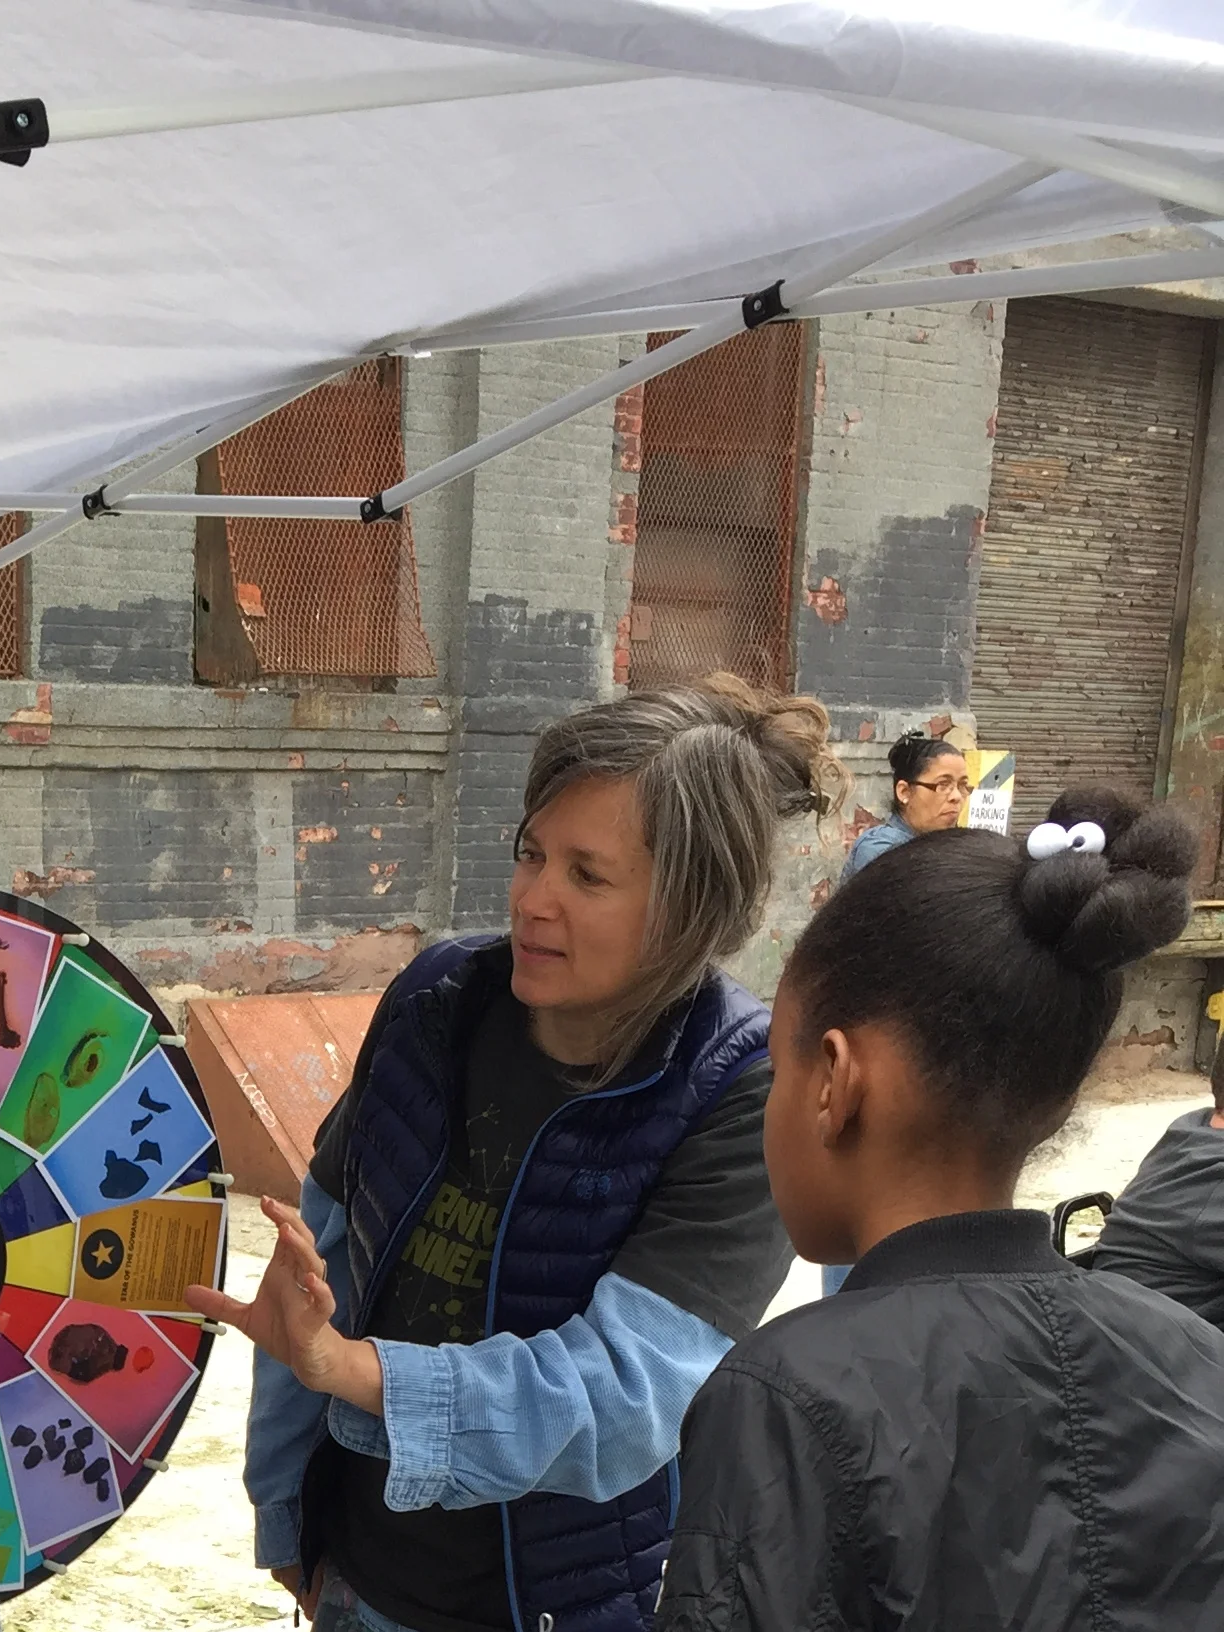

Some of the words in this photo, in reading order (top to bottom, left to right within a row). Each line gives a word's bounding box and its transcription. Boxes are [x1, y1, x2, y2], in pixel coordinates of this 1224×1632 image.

[982, 793, 995, 805] NO
[970, 807, 1005, 820] PARKING
[124, 1266, 131, 1280] OF
[128, 1209, 140, 1252] GOWANUS
